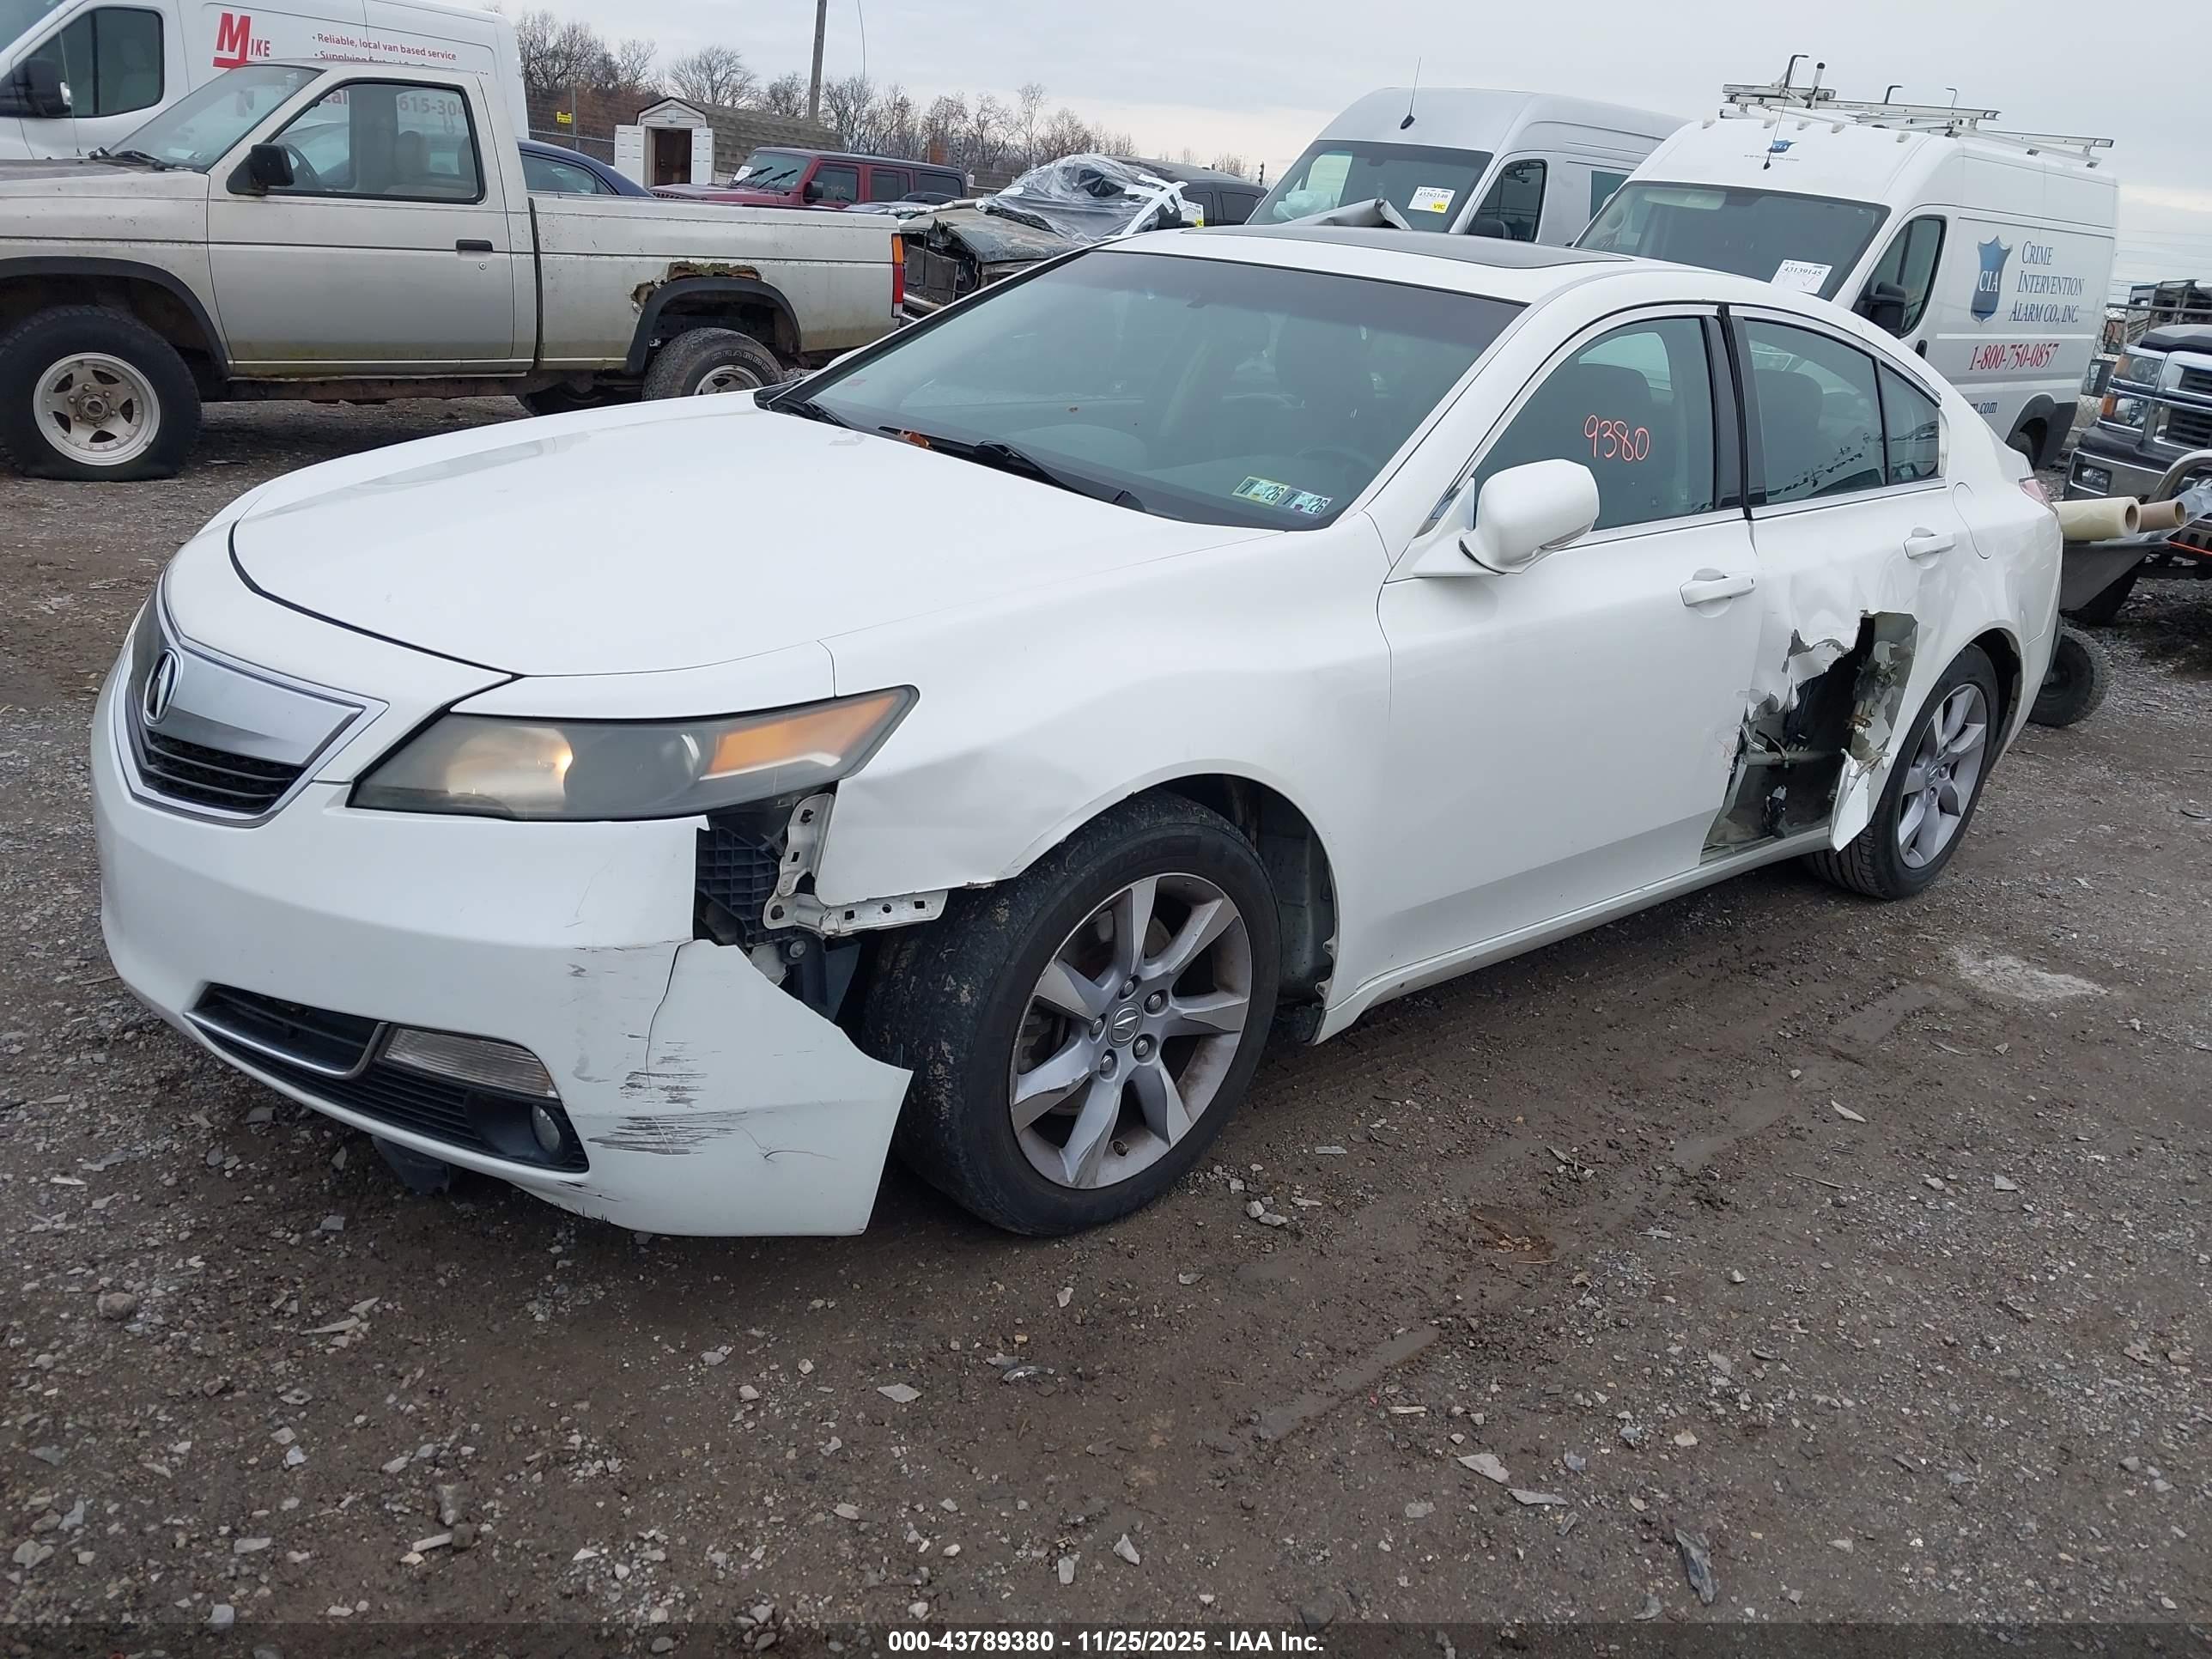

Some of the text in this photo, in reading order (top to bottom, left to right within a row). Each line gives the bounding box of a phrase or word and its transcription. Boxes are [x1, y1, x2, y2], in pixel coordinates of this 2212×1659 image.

[317, 33, 457, 61] Reliable, local van based service
[1978, 270, 1999, 292] CIA
[2016, 270, 2085, 296] INTERVENTION
[2008, 299, 2044, 322] ALARM
[2061, 305, 2081, 323] INC.
[1968, 343, 2060, 371] 1-800-750-0857
[1584, 414, 1650, 461] 9380
